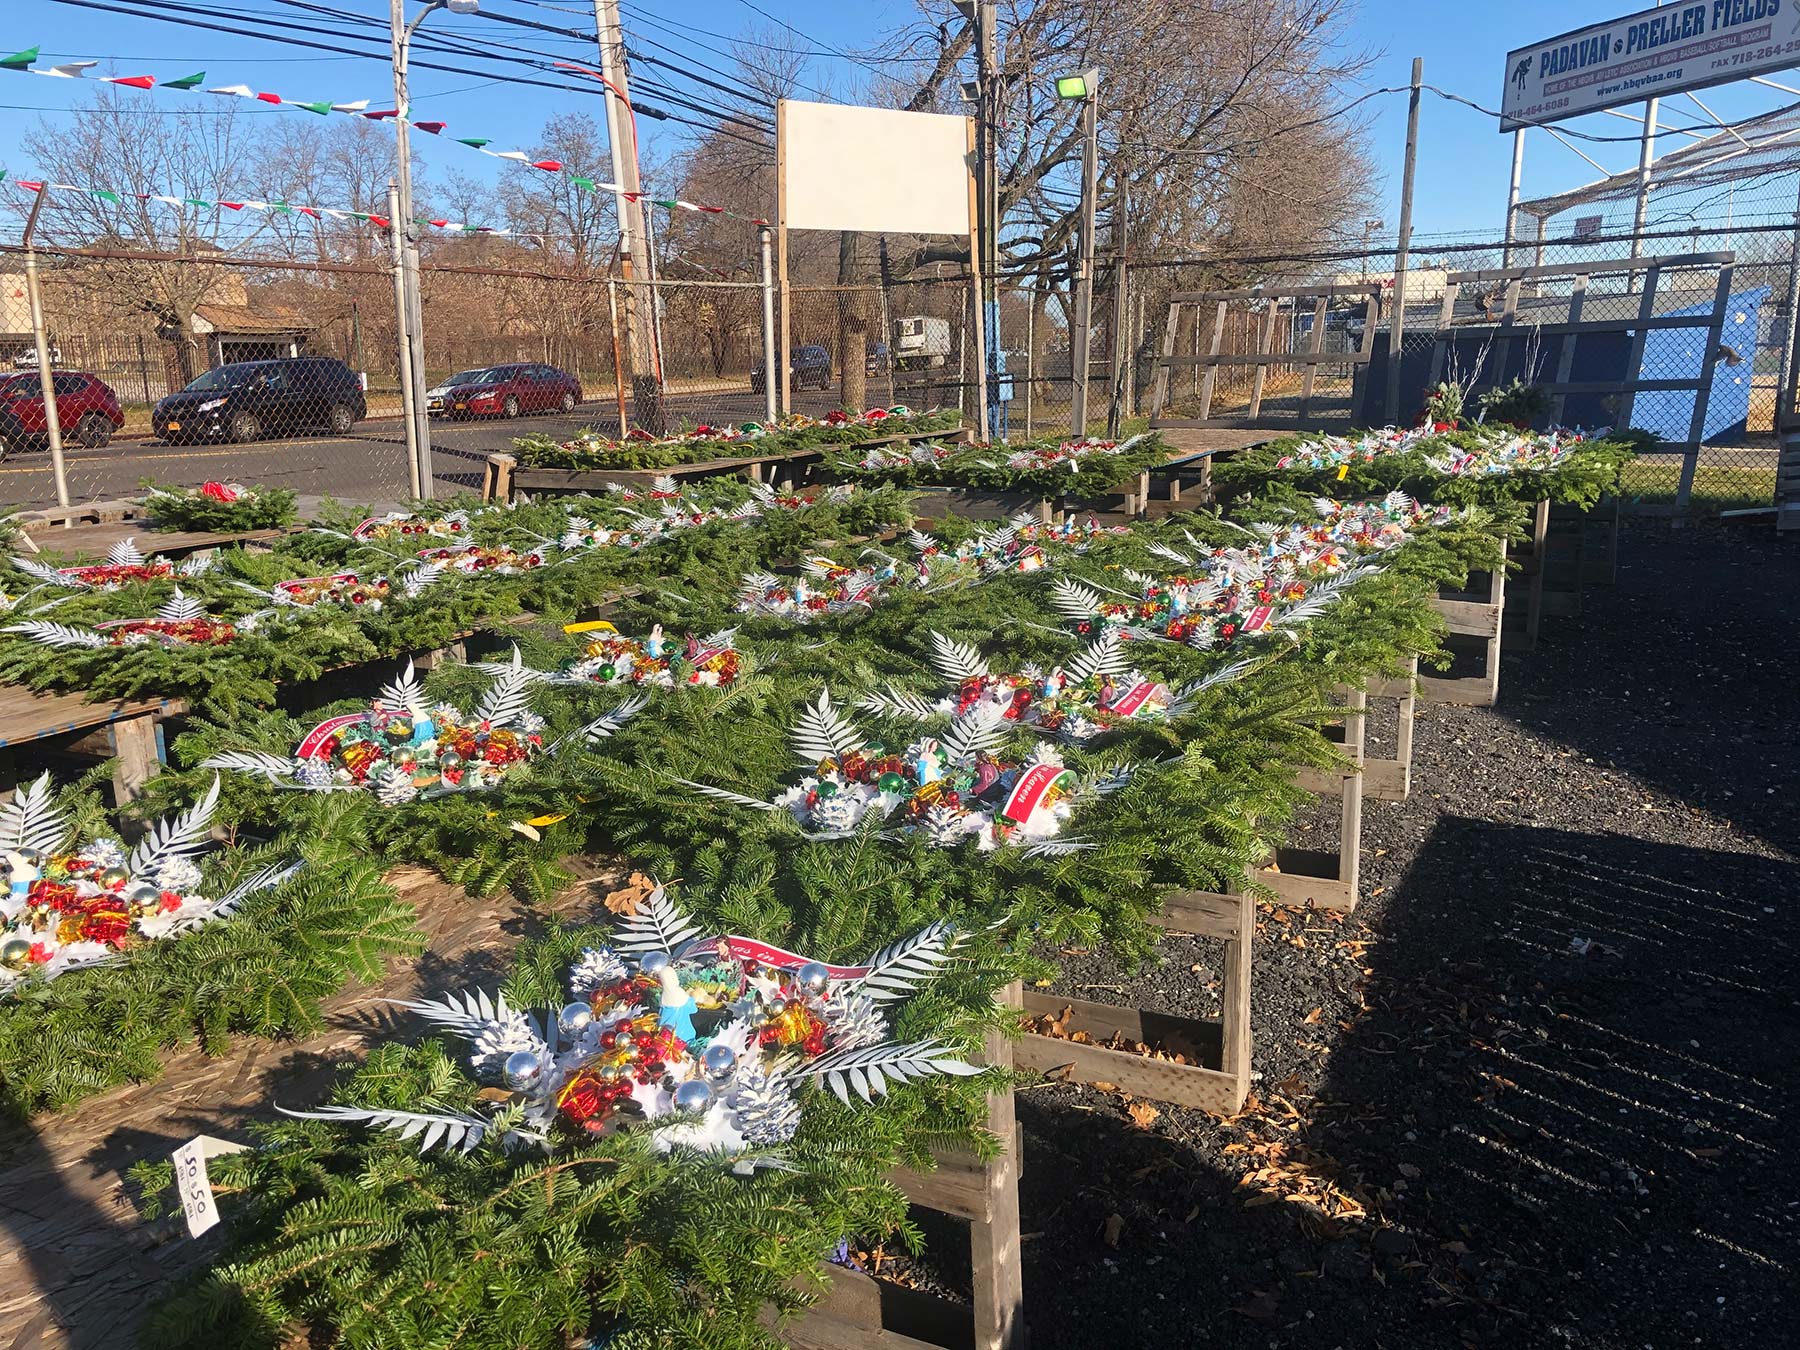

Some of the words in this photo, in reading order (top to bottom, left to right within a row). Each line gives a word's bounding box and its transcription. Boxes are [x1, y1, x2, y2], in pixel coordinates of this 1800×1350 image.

[1540, 33, 1612, 79] PADAVAN
[1626, 5, 1706, 55] PRELLER
[1711, 0, 1780, 31] FIELDS
[1711, 58, 1730, 70] FAX
[1017, 771, 1047, 803] Heaven
